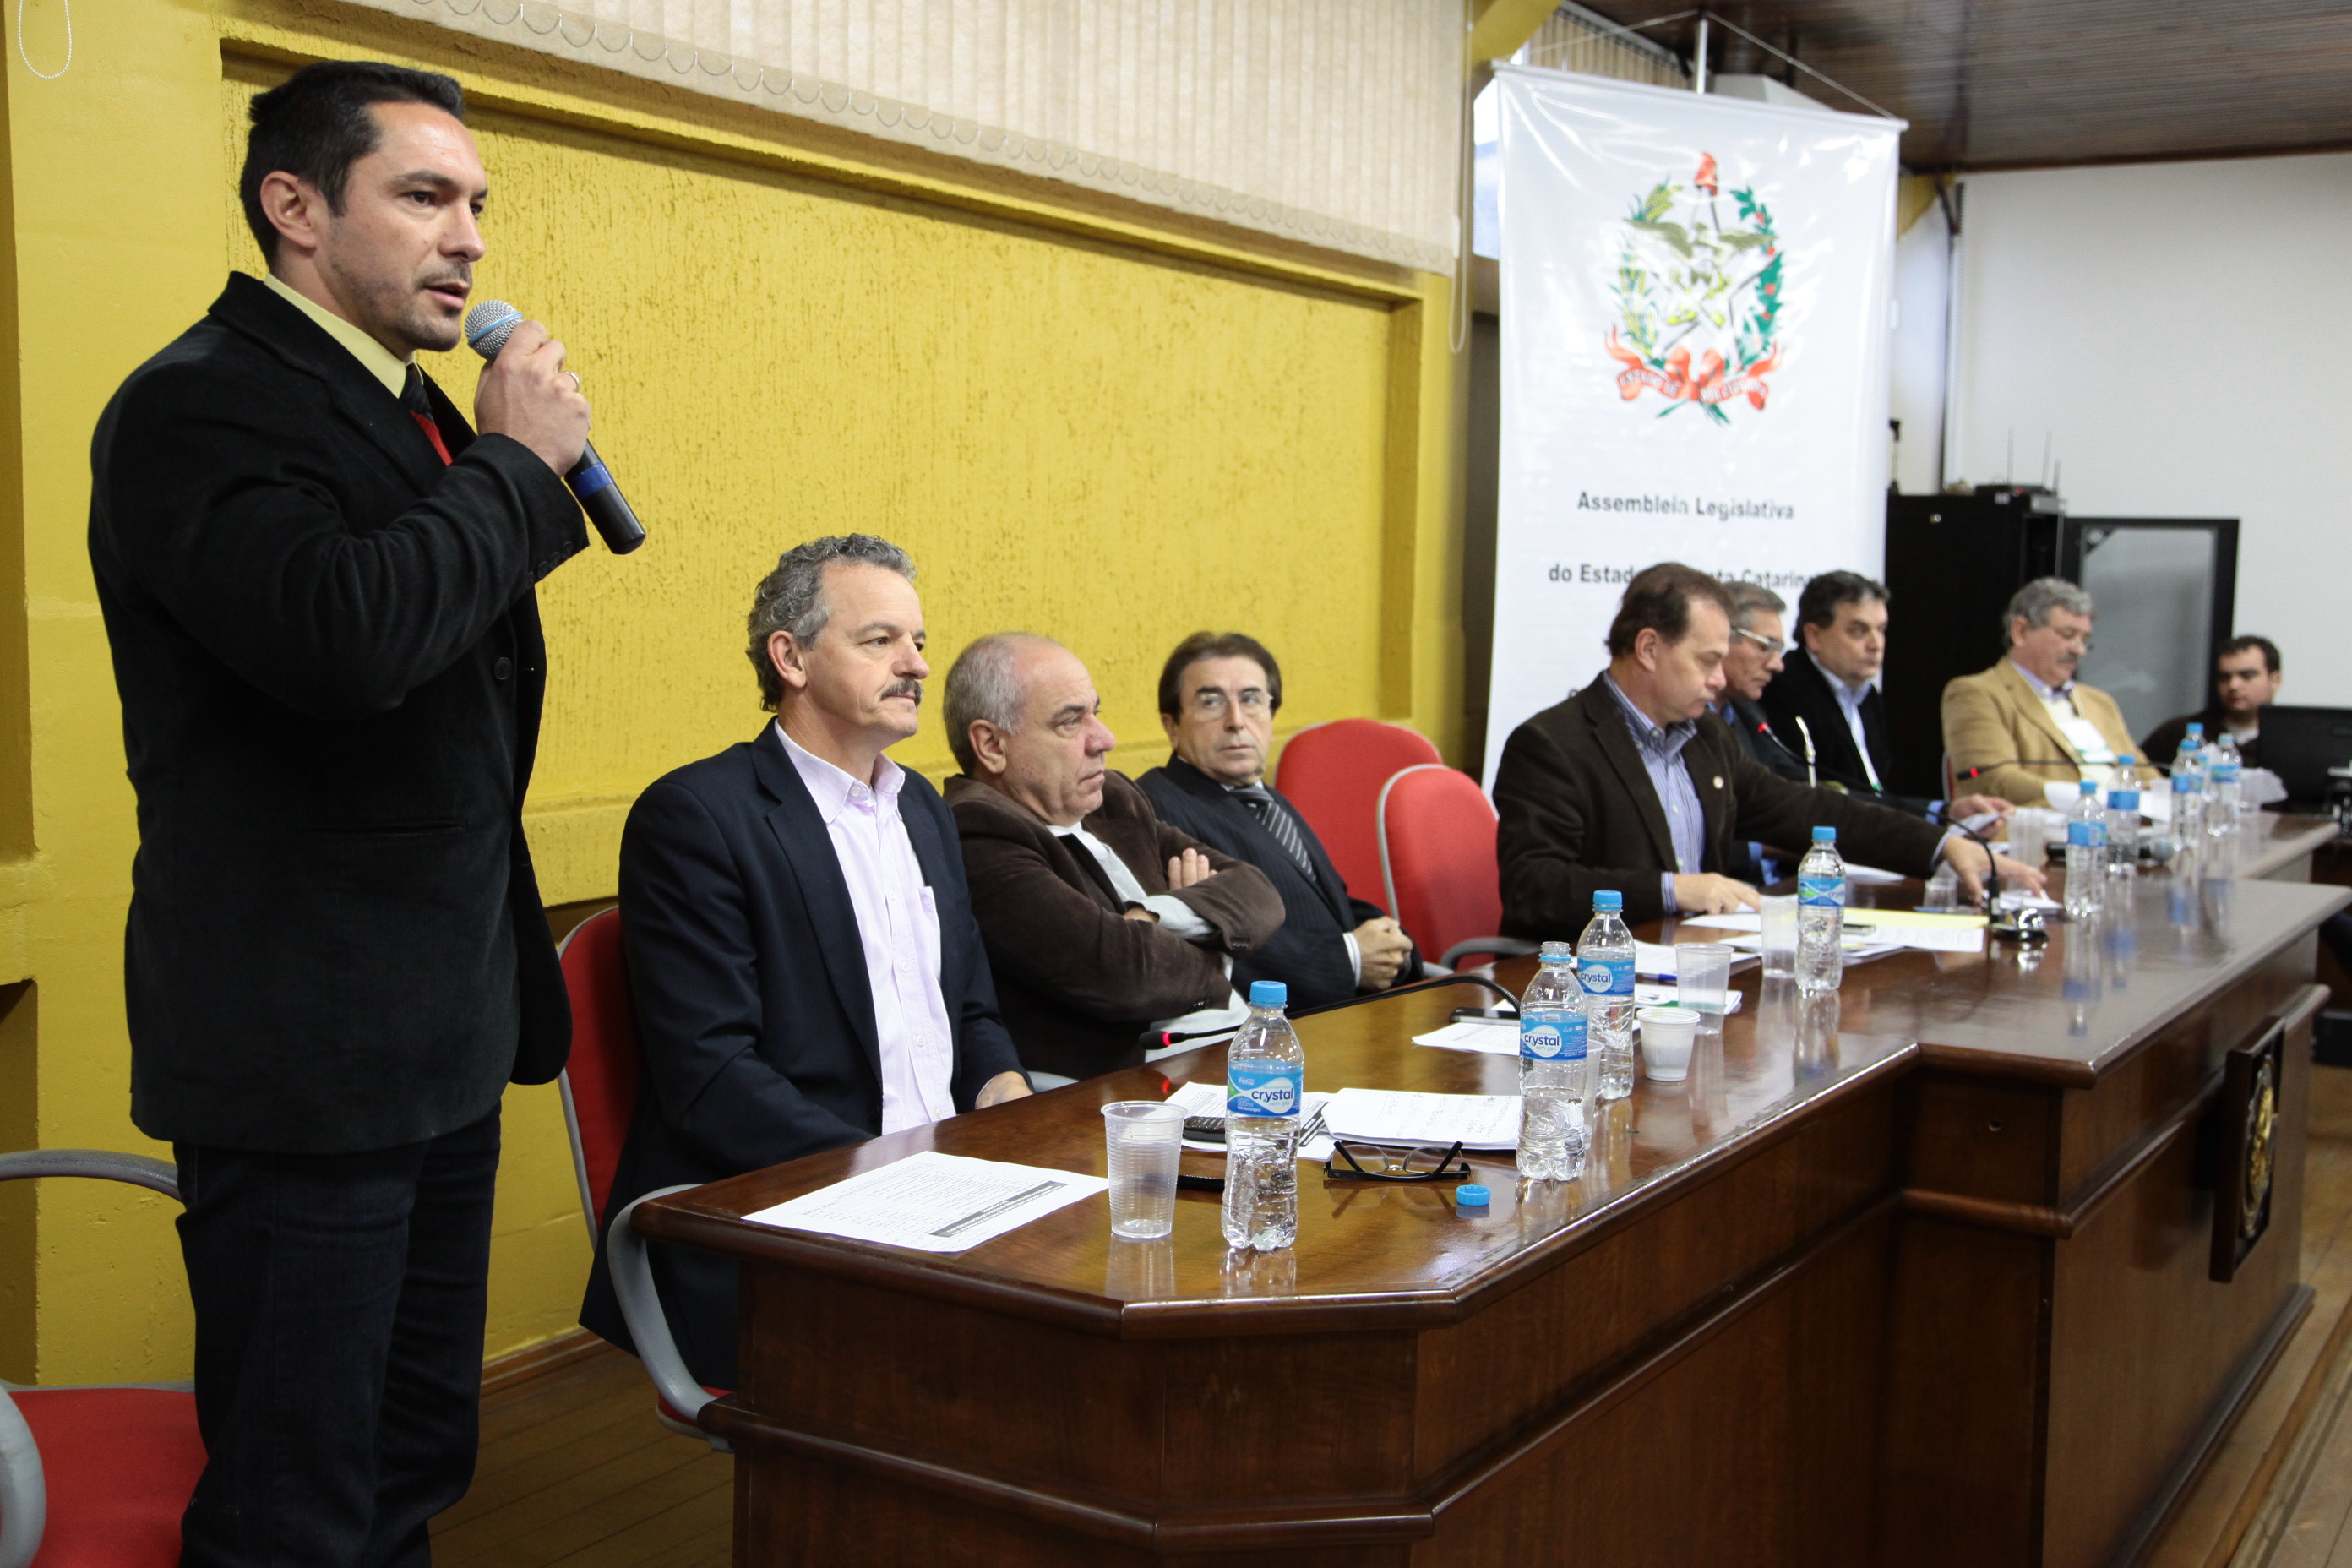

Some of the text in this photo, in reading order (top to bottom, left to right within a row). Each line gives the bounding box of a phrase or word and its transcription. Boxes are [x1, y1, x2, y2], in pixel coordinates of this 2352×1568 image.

[1696, 497, 1794, 521] Legislativa
[1549, 563, 1572, 581] do
[1580, 564, 1635, 583] Estad
[1742, 569, 1806, 589] Catarin
[1580, 972, 1611, 983] crystal
[1524, 1034, 1560, 1046] crystal
[1251, 1087, 1293, 1102] crystal
